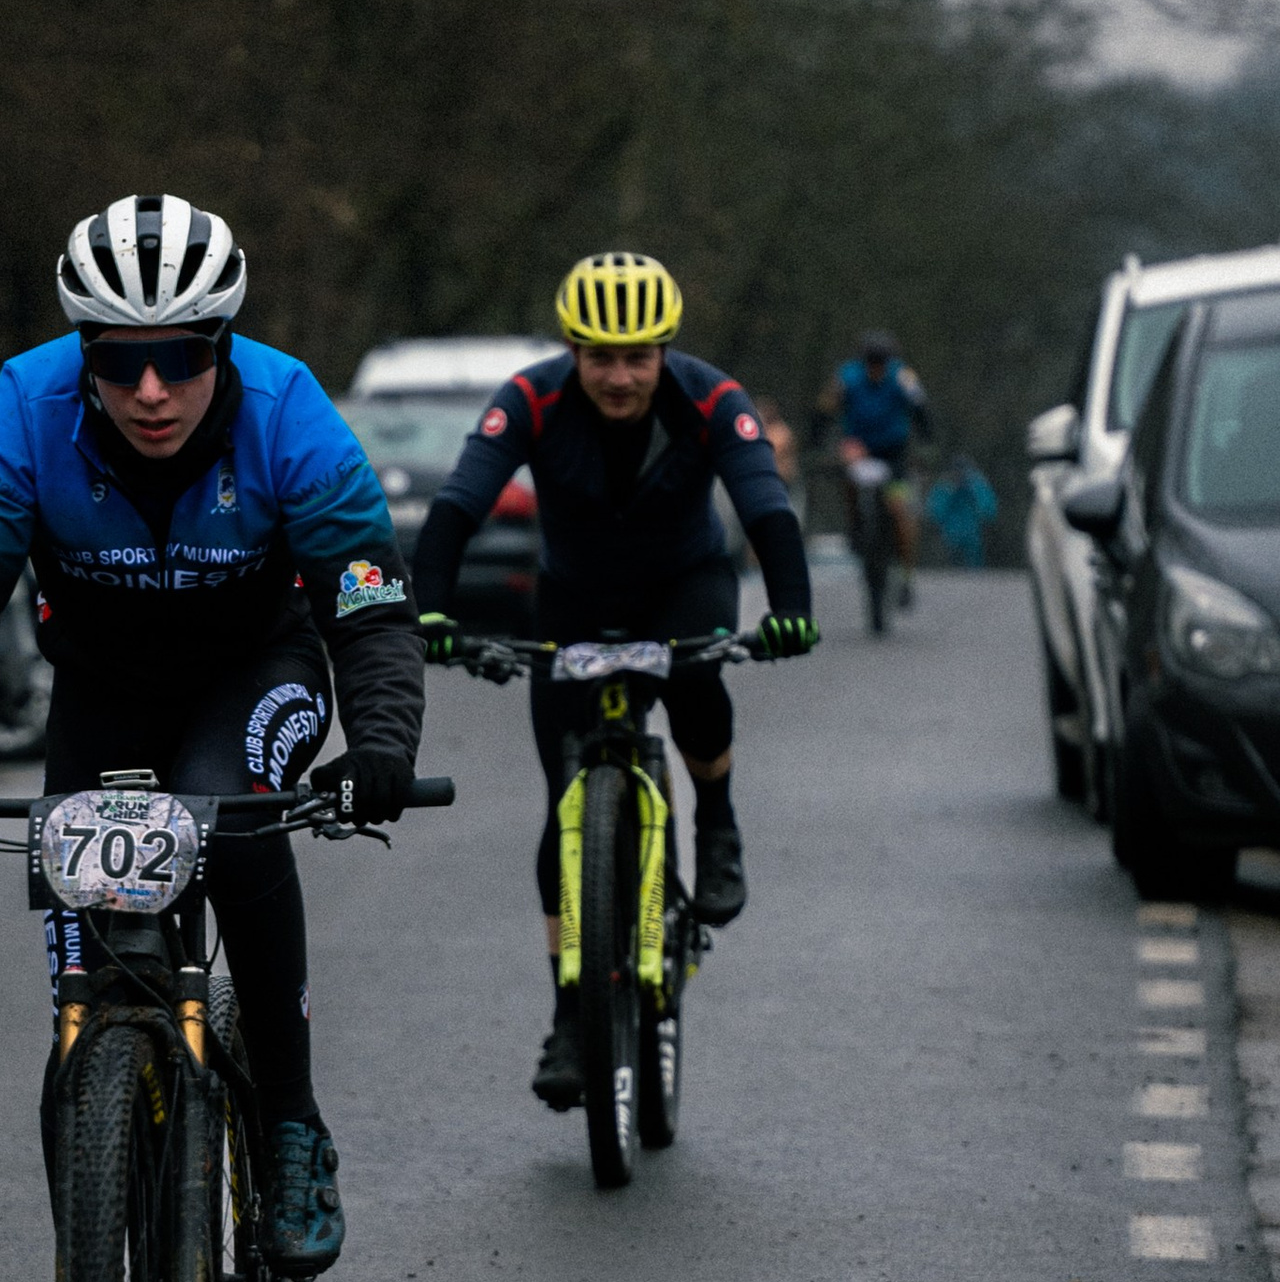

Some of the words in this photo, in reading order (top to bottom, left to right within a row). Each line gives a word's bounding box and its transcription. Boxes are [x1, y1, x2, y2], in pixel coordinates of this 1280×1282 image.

[246, 736, 264, 774] CLUB
[113, 810, 149, 820] RIDE
[115, 800, 150, 811] RUN
[62, 826, 179, 883] 702
